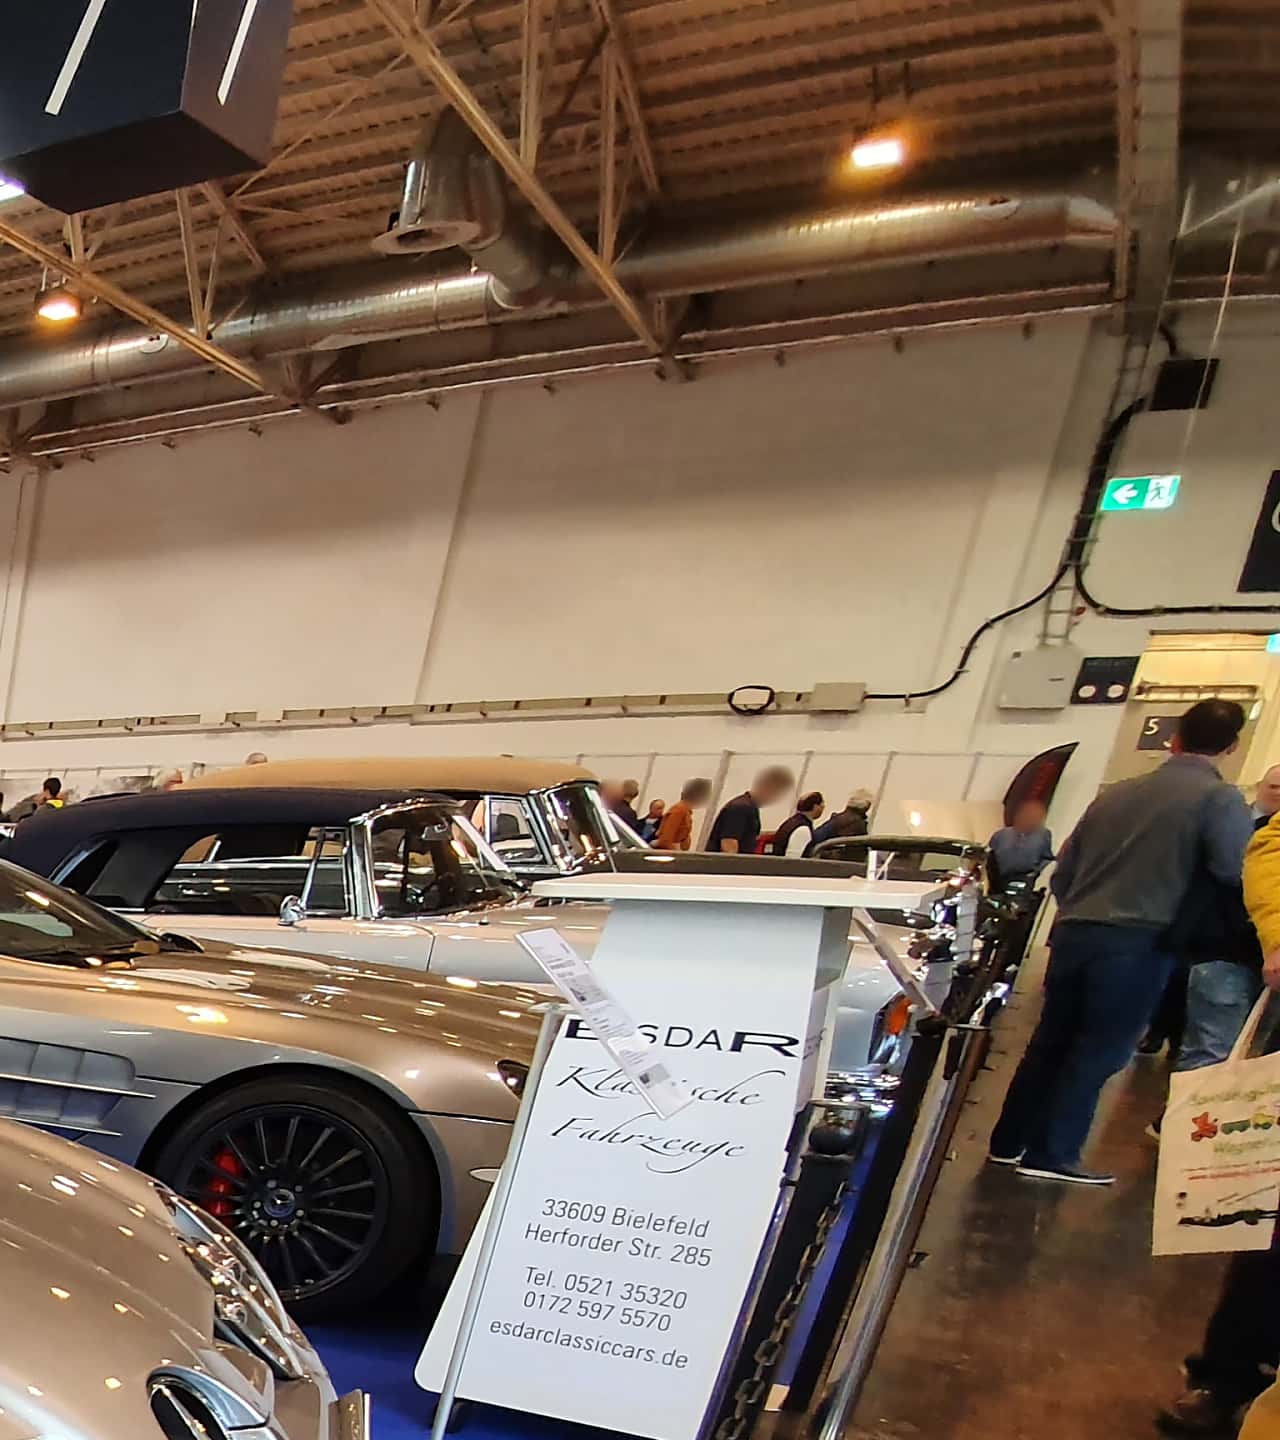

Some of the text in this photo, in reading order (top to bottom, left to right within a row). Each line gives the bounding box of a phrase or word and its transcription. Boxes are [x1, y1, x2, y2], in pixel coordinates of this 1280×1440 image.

[551, 1112, 745, 1174] Fahrzeuge
[542, 1198, 710, 1239] 33609 Bielefeld
[524, 1222, 712, 1267] Herforder Str. 285
[526, 1266, 687, 1310] Tel. 0521 35320
[523, 1291, 671, 1332] 0172 597 5570
[490, 1319, 689, 1369] esdarclassiccars.de
